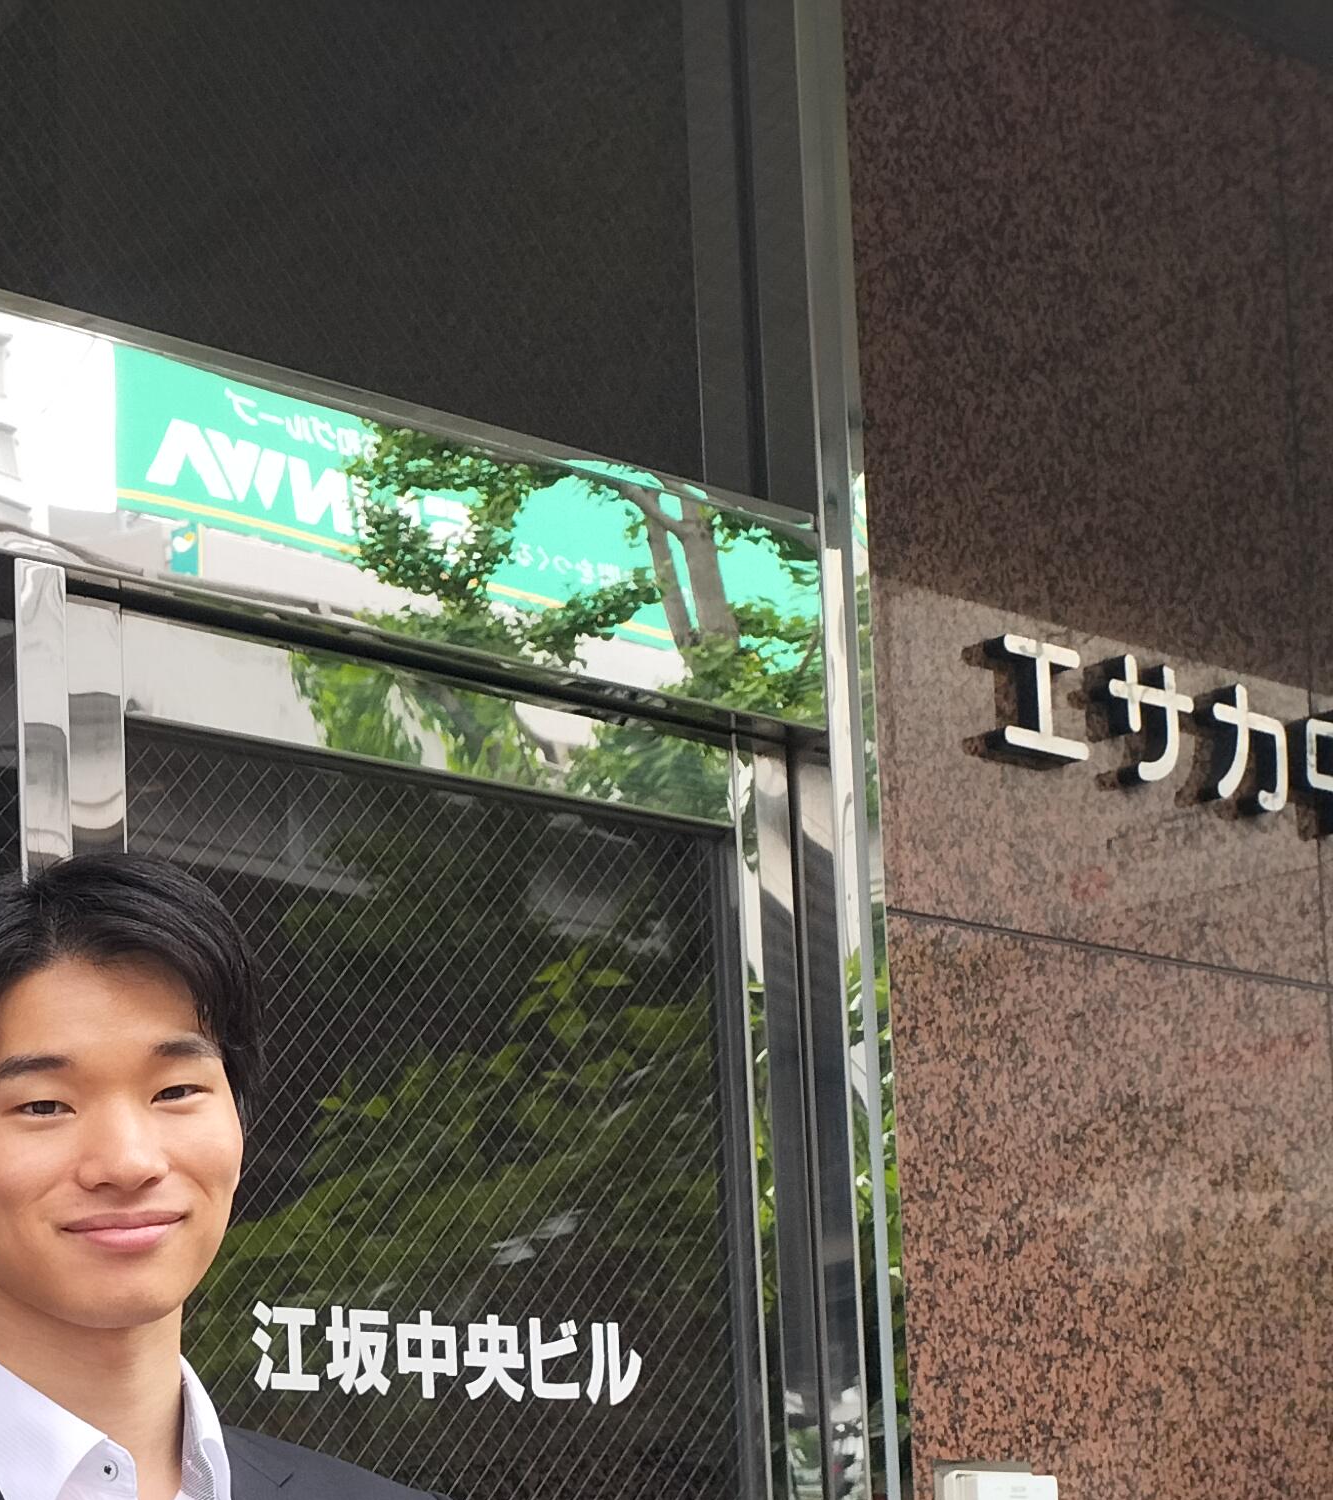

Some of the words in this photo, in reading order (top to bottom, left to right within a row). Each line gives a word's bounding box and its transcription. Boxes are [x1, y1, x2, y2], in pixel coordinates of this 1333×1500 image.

[252, 1300, 643, 1406] 江坂中央ビル
